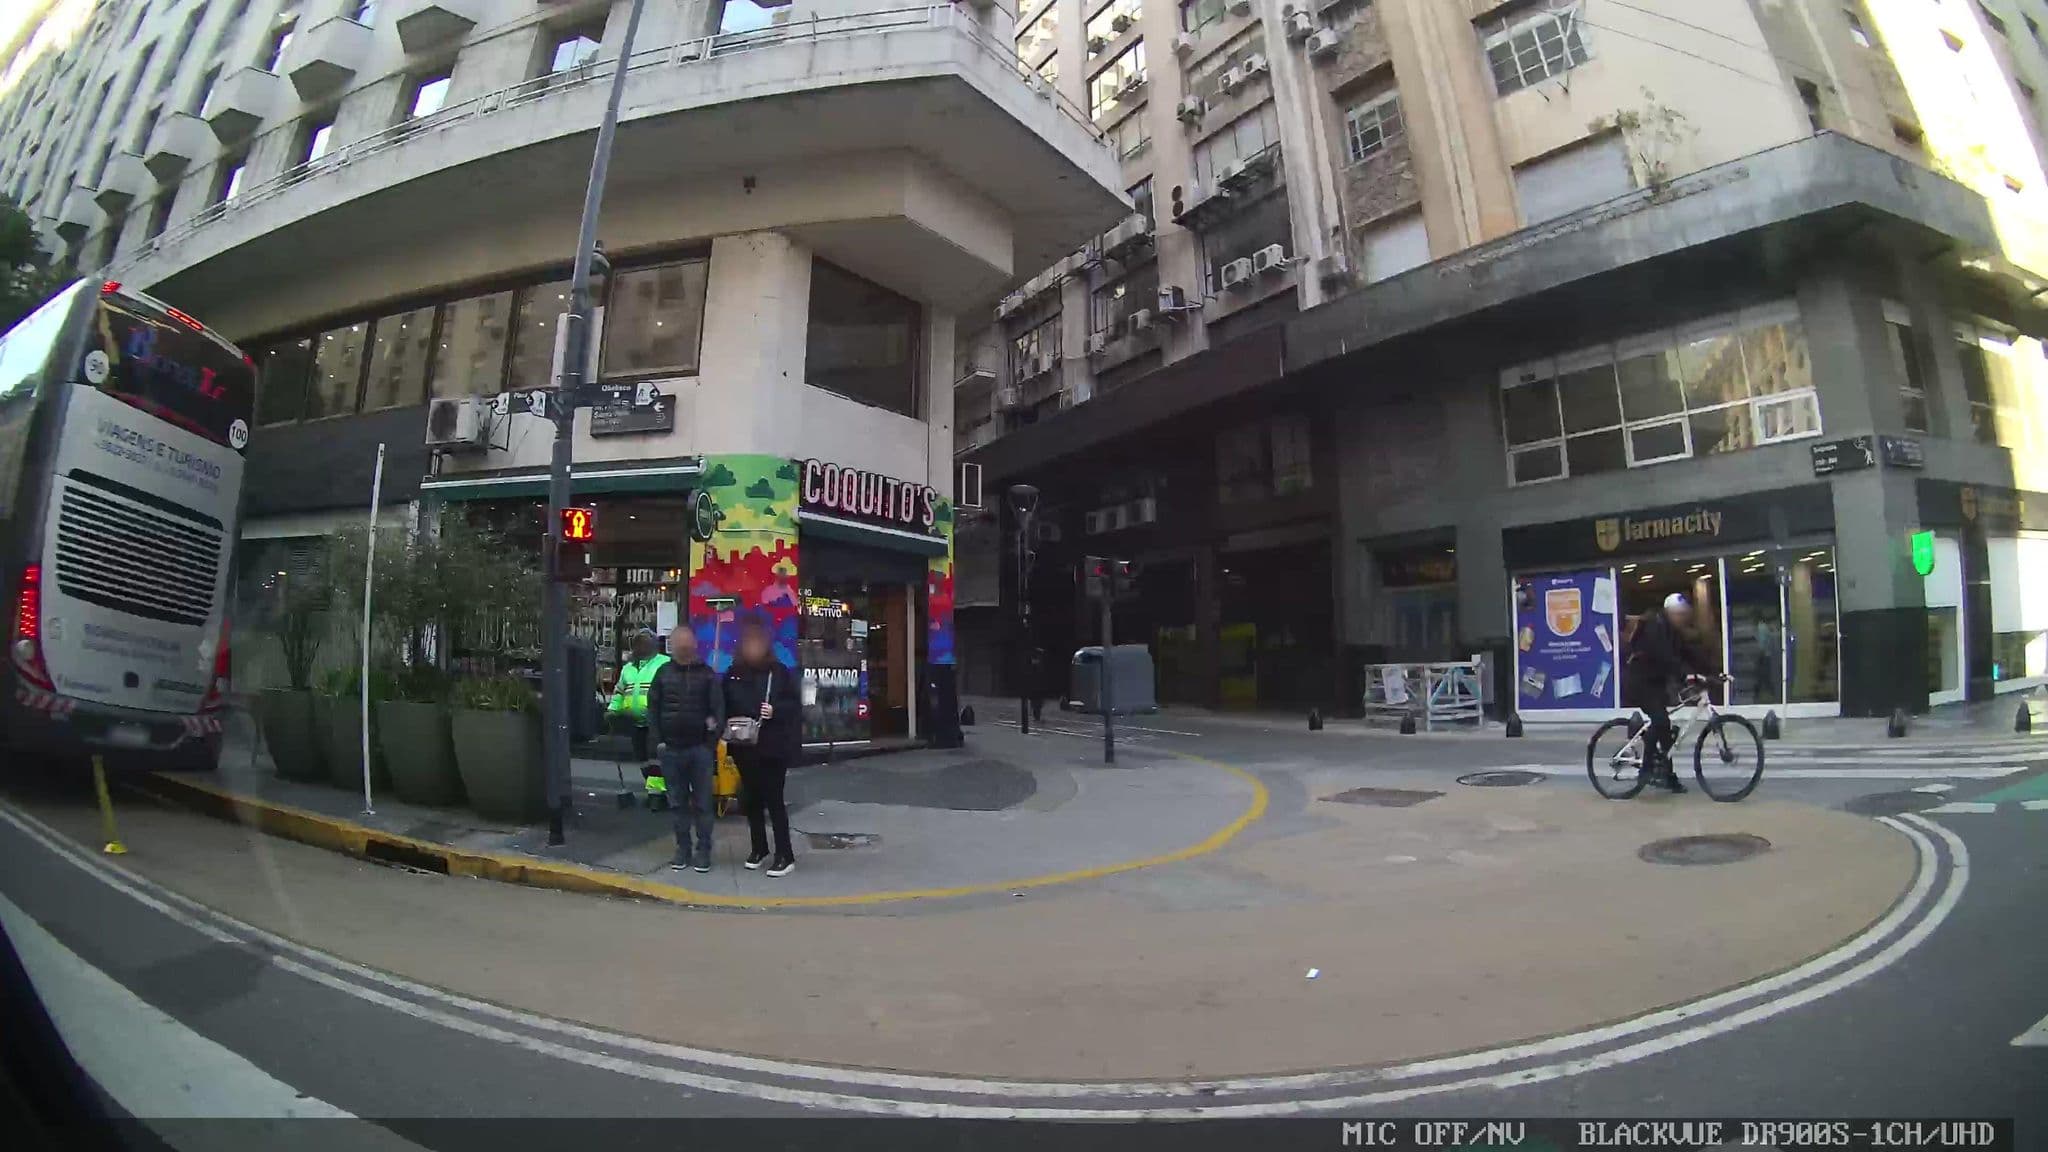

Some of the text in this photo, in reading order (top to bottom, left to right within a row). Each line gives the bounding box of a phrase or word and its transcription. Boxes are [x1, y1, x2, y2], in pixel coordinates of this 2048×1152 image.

[98, 417, 154, 453] VIAGENS
[156, 441, 167, 457] E
[168, 445, 221, 480] TURISMO
[232, 425, 247, 442] 100
[804, 459, 936, 527] COQUITO'S
[1624, 508, 1722, 540] farmacity
